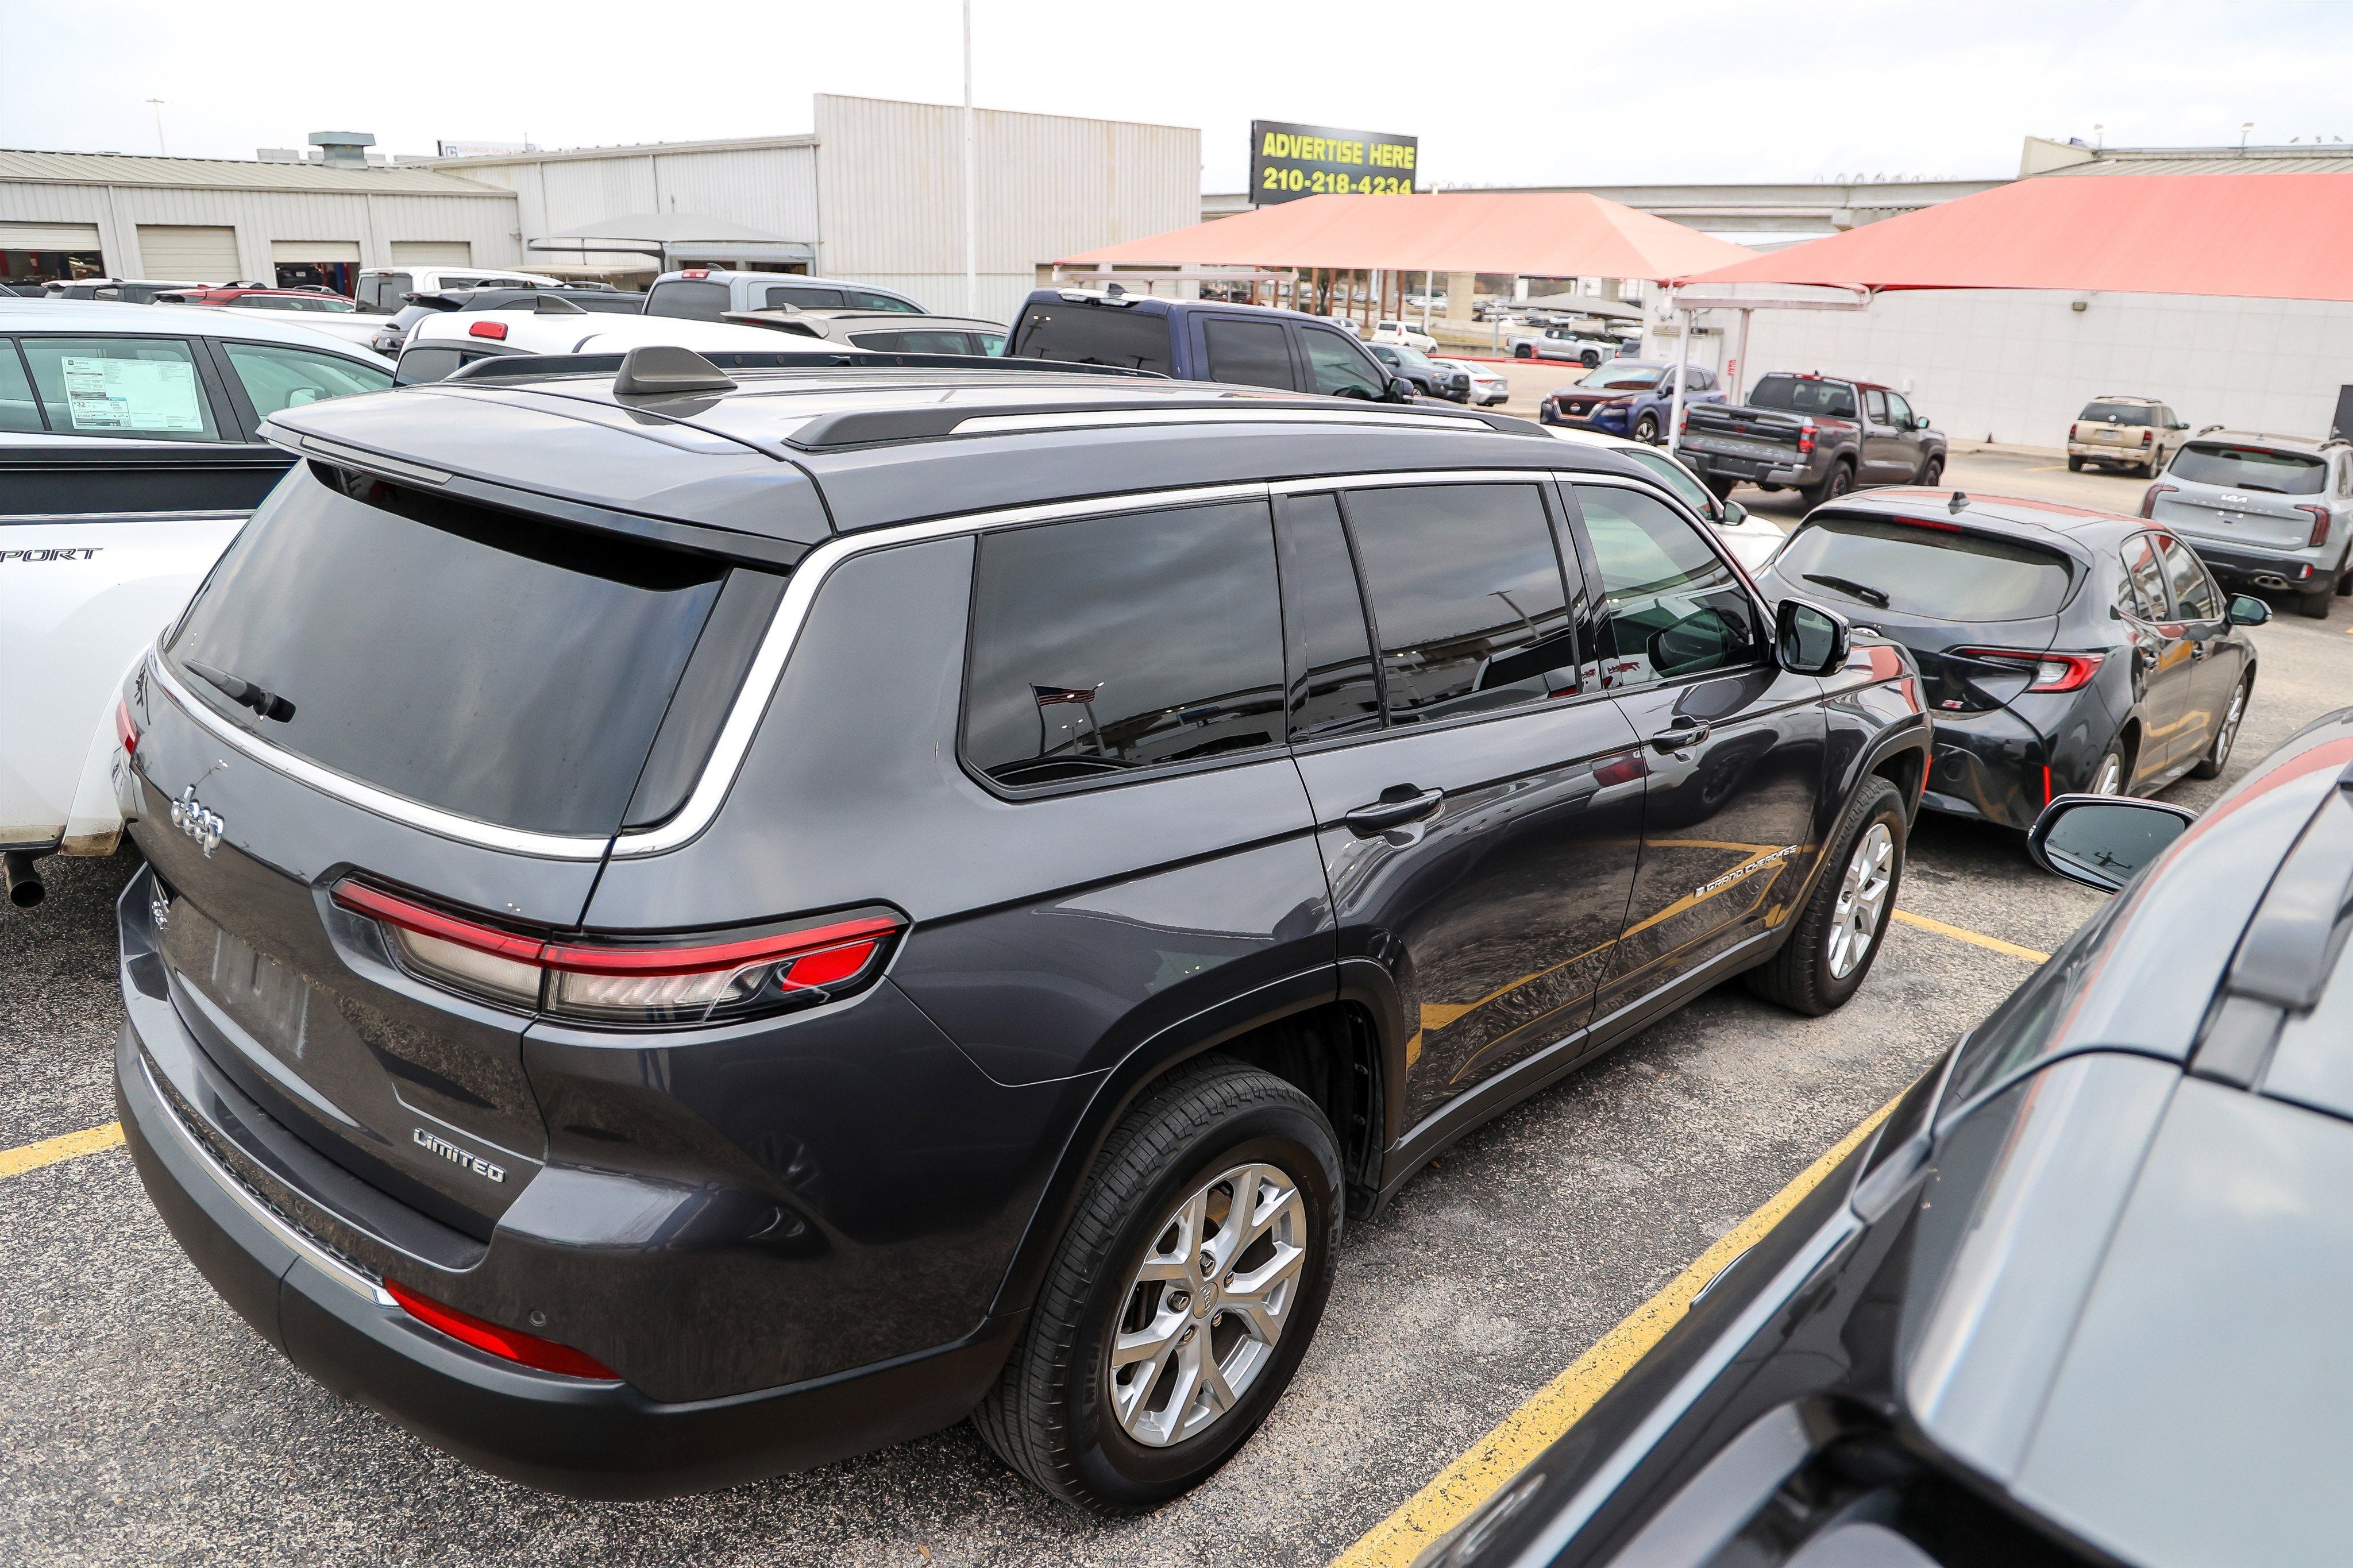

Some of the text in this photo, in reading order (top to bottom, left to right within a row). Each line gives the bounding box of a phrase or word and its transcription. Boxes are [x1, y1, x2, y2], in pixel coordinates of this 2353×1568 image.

[1262, 132, 1415, 170] ADVERTISE HERE
[1263, 167, 1413, 195] 210-218-4234
[171, 783, 225, 859] Jeep
[1706, 844, 1798, 893] GRAND CHEROKEE
[413, 1127, 508, 1183] LIMITED
